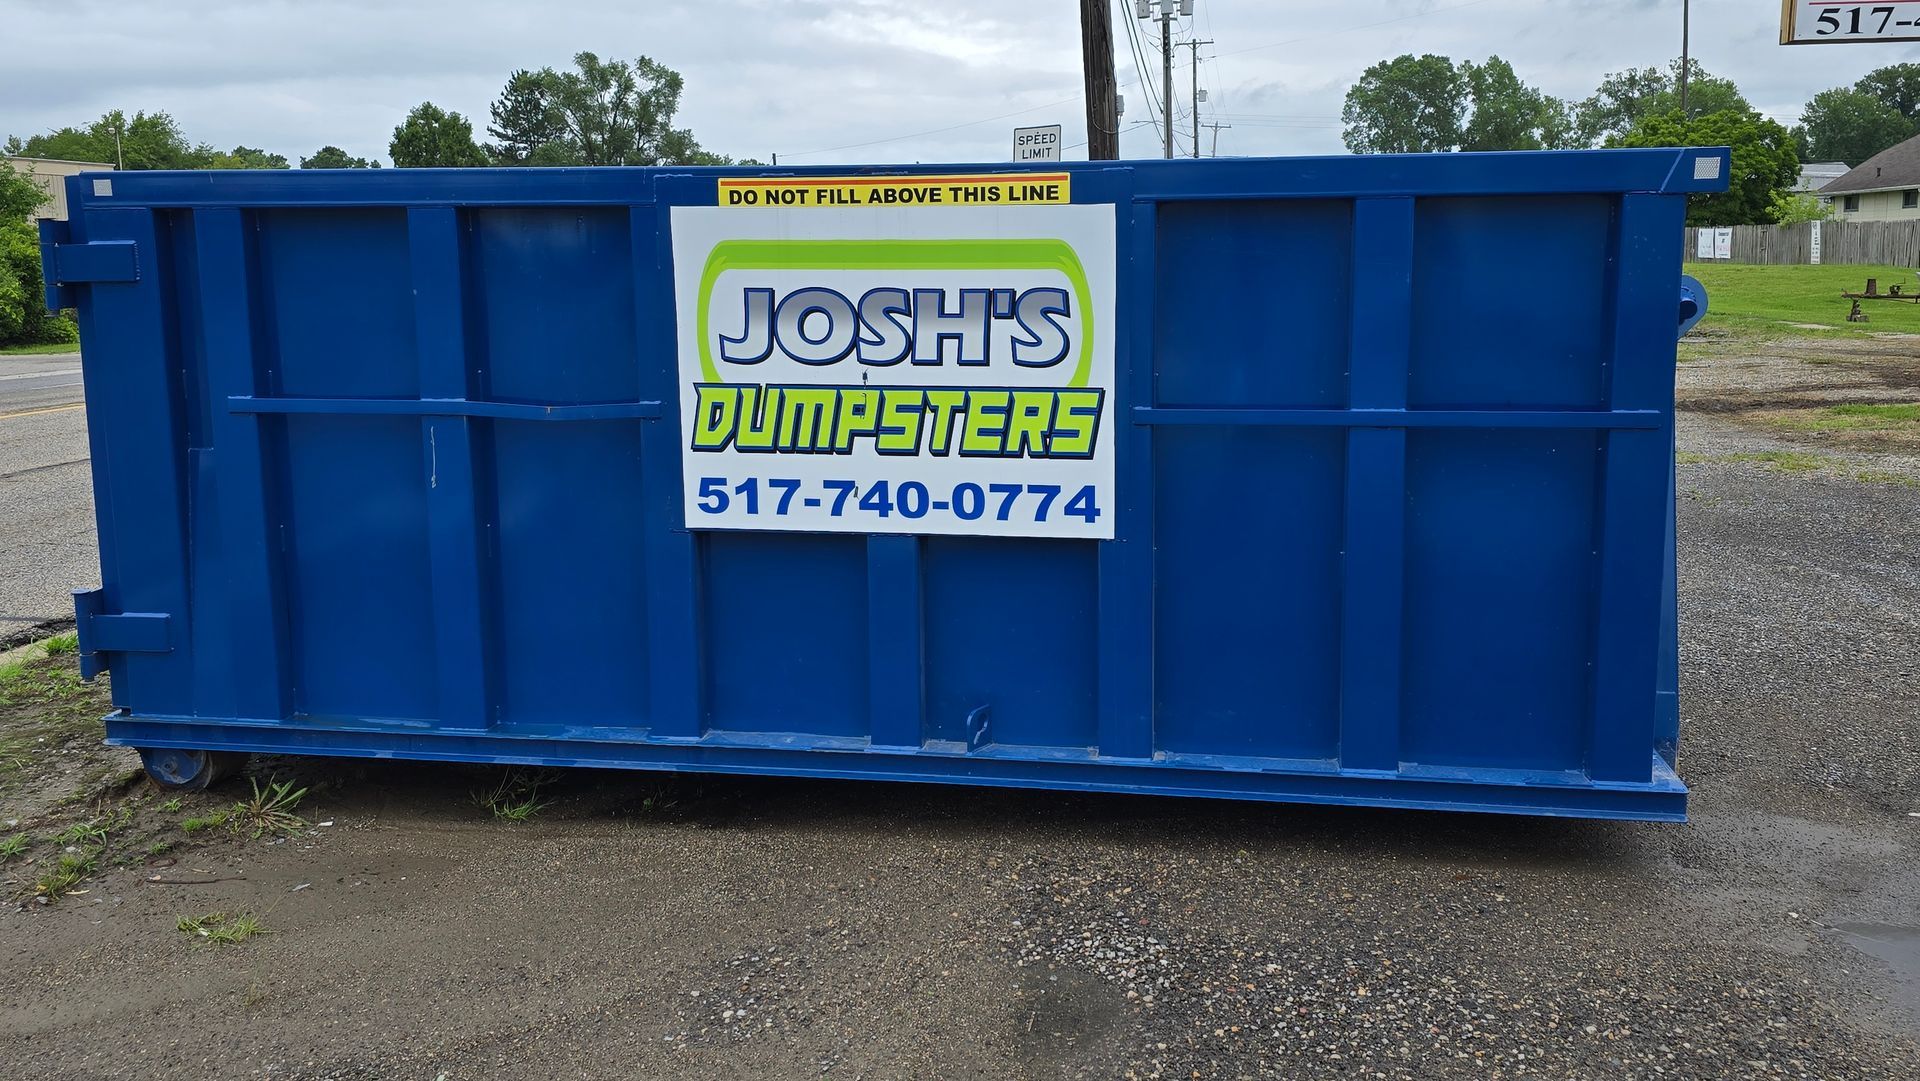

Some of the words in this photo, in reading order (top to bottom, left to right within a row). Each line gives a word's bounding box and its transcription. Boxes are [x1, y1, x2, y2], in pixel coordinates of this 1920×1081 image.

[1018, 133, 1056, 146] SPEED
[1022, 147, 1052, 159] LIMIT
[729, 189, 758, 205] DO
[765, 189, 809, 205] NOT
[816, 188, 861, 204] FILL
[868, 187, 942, 204] ABOVE
[949, 186, 1001, 203] THIS
[1008, 184, 1060, 201] LINE
[719, 286, 1071, 368] JOSH'S
[691, 382, 1105, 460] DUMPSTERS
[697, 476, 1101, 524] 517-740-0774
